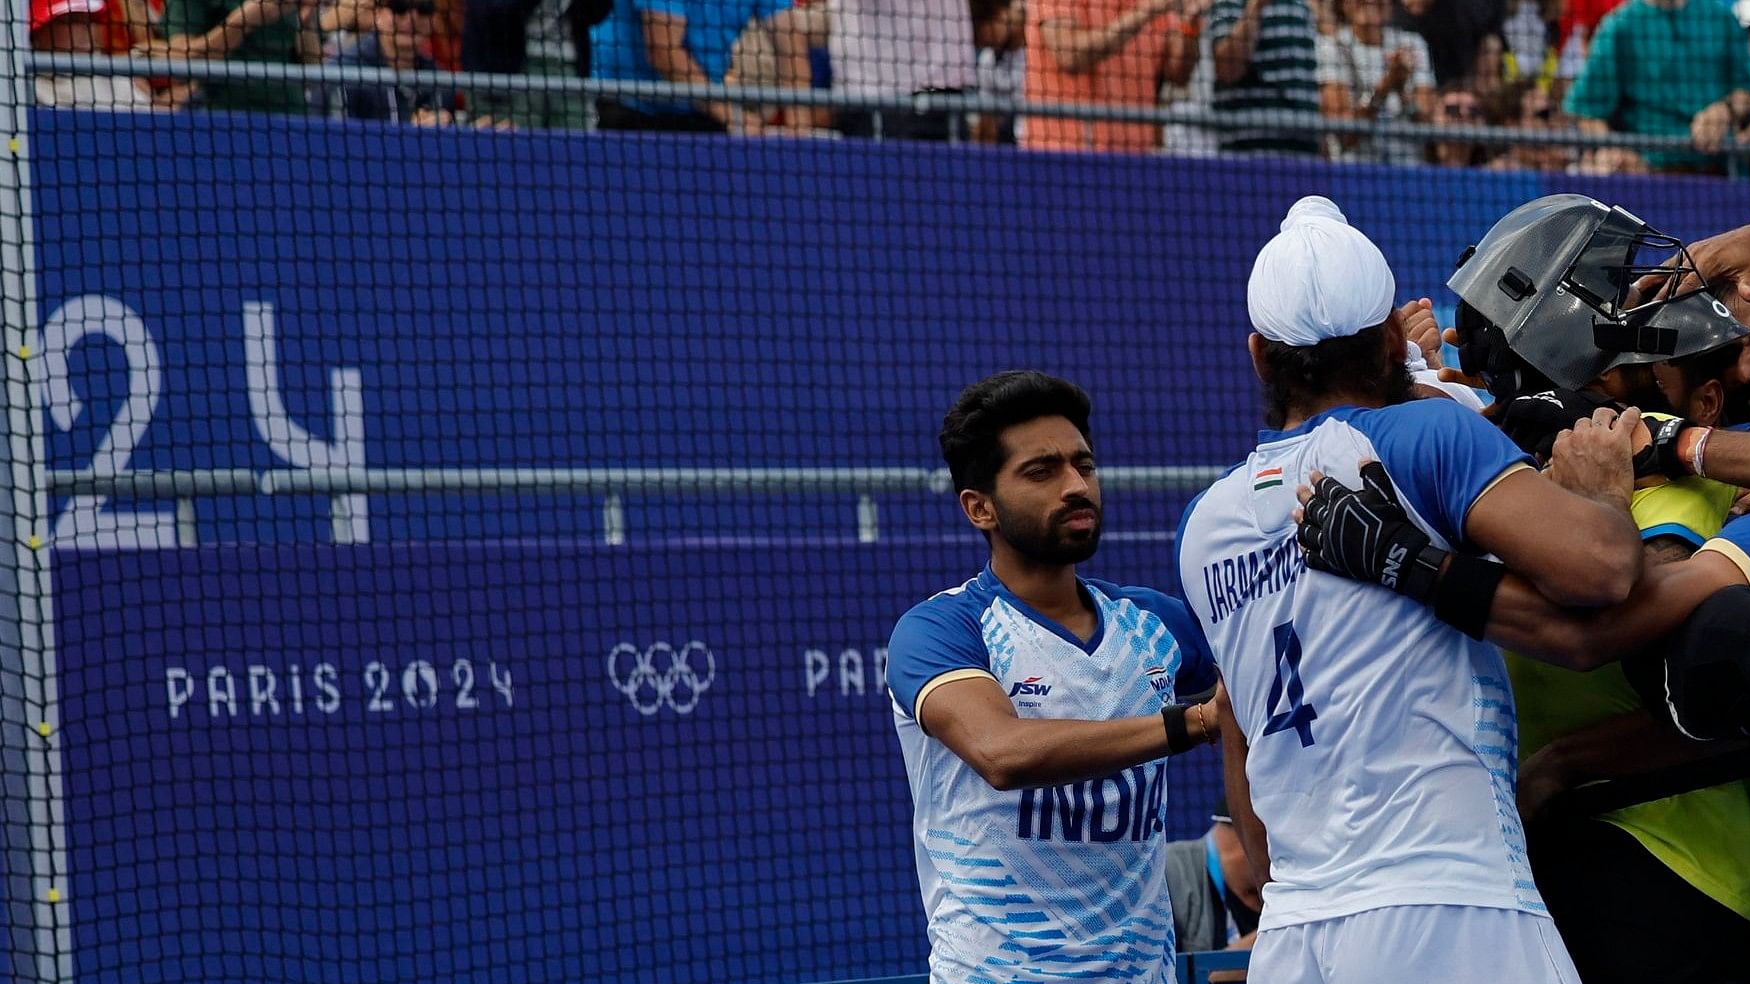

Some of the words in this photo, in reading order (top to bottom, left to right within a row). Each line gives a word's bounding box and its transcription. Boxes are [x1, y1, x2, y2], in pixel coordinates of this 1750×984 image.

[364, 658, 515, 712] 2024
[1008, 681, 1052, 698] JSW
[1018, 700, 1042, 709] Inspire
[1263, 616, 1318, 748] 4
[1016, 763, 1165, 842] INDIA
